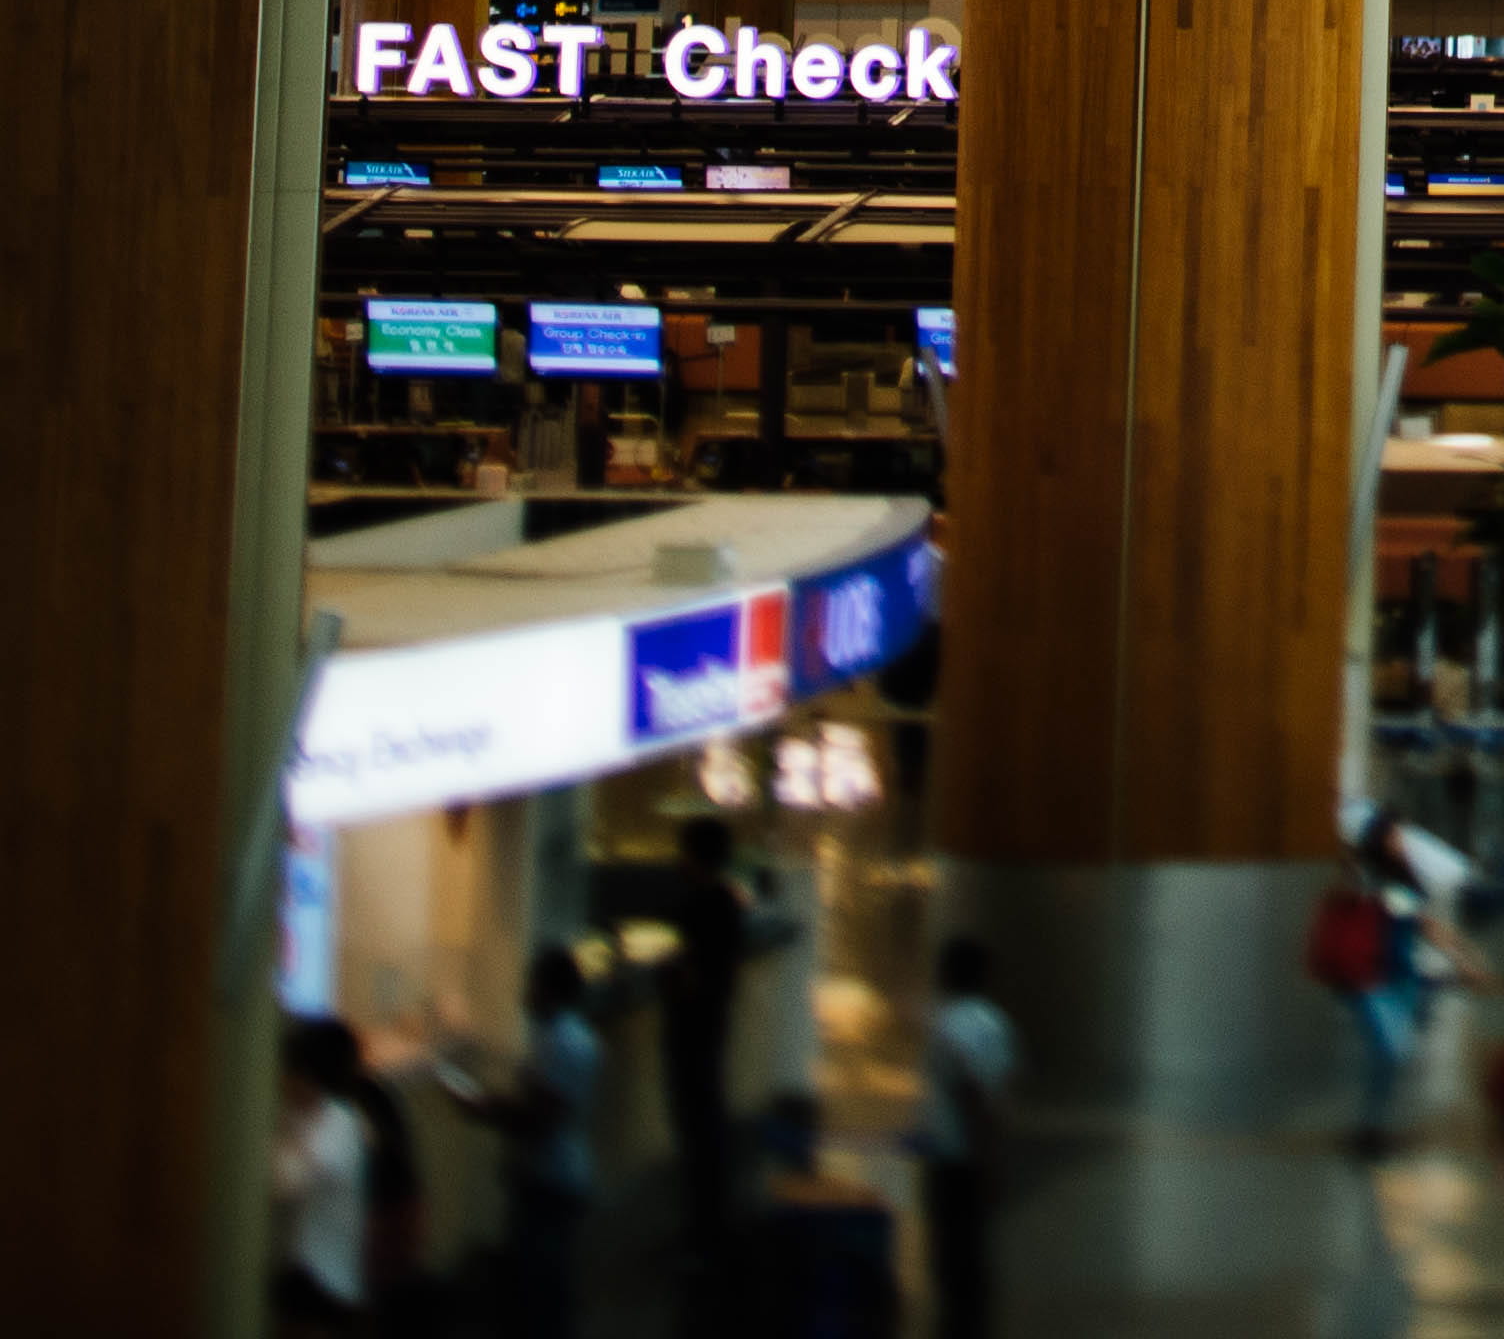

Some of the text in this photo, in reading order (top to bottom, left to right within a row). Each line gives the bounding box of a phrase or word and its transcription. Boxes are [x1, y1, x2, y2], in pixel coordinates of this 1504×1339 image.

[355, 22, 960, 101] FAST Check
[381, 323, 482, 338] Economy Class
[543, 326, 647, 342] Group Check-in
